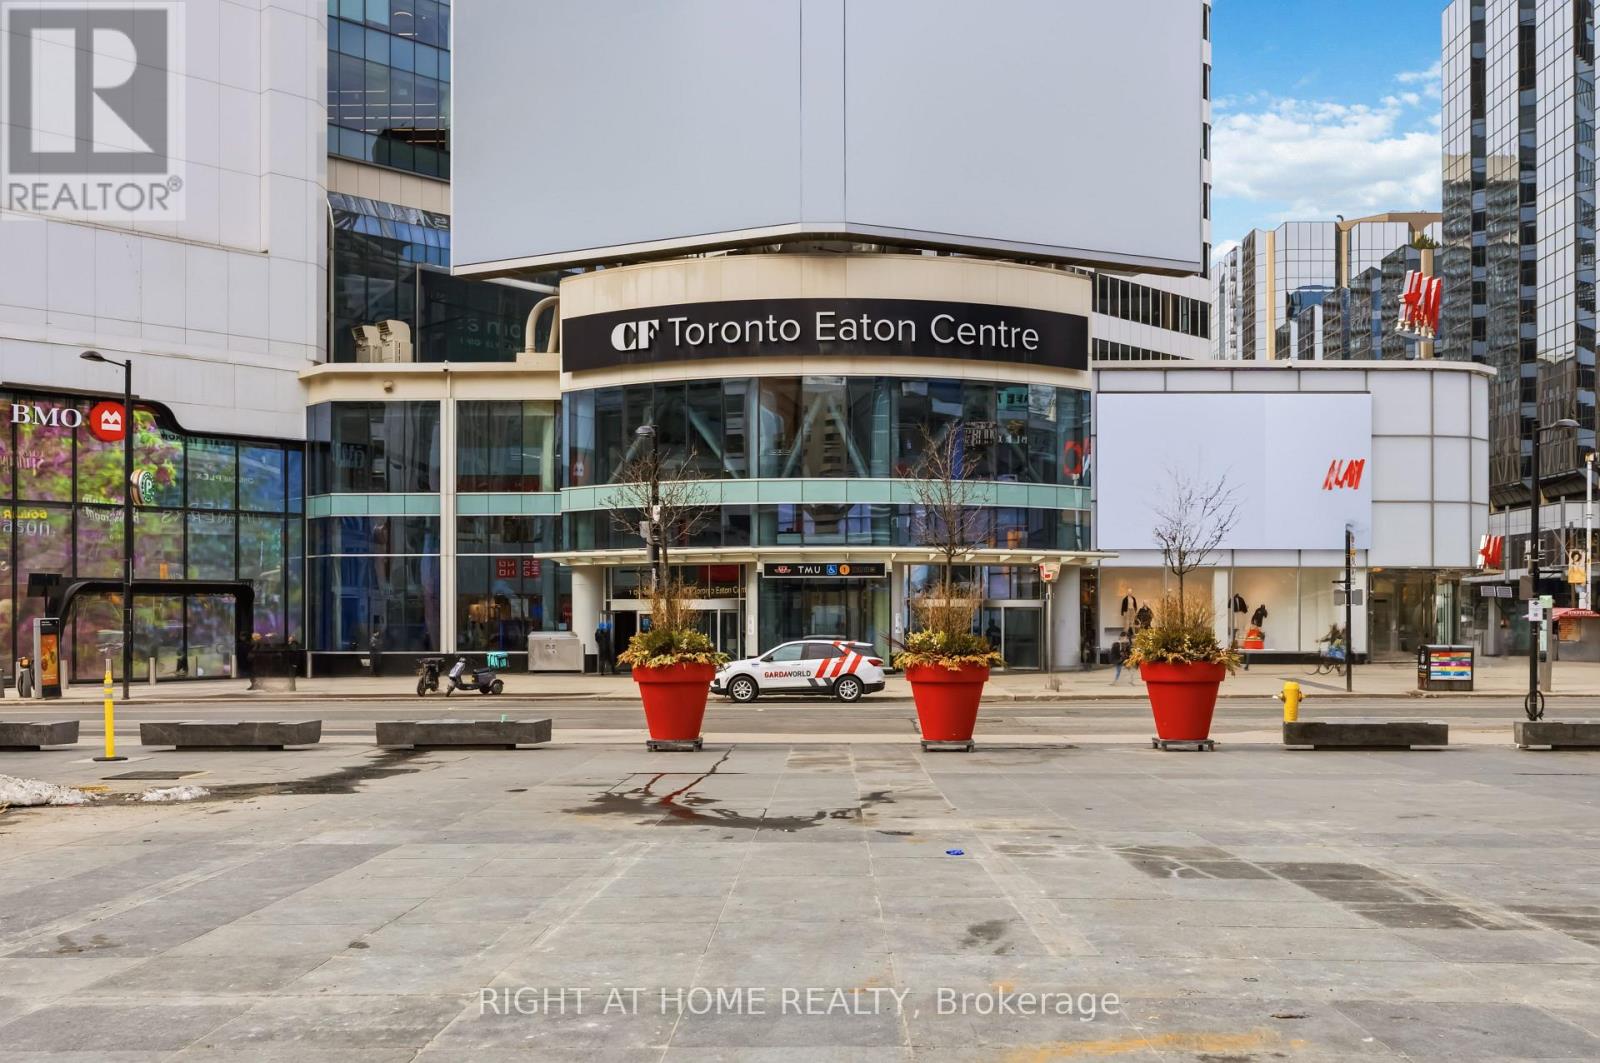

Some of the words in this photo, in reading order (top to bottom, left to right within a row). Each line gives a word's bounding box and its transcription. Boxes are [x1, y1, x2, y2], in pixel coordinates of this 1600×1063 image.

[610, 319, 660, 352] CF
[668, 314, 801, 347] Toronto
[815, 311, 916, 343] Eaton
[929, 313, 1040, 351] Centre
[10, 403, 82, 428] BMO
[797, 565, 821, 574] TMU
[764, 670, 811, 679] GARDAWORLD
